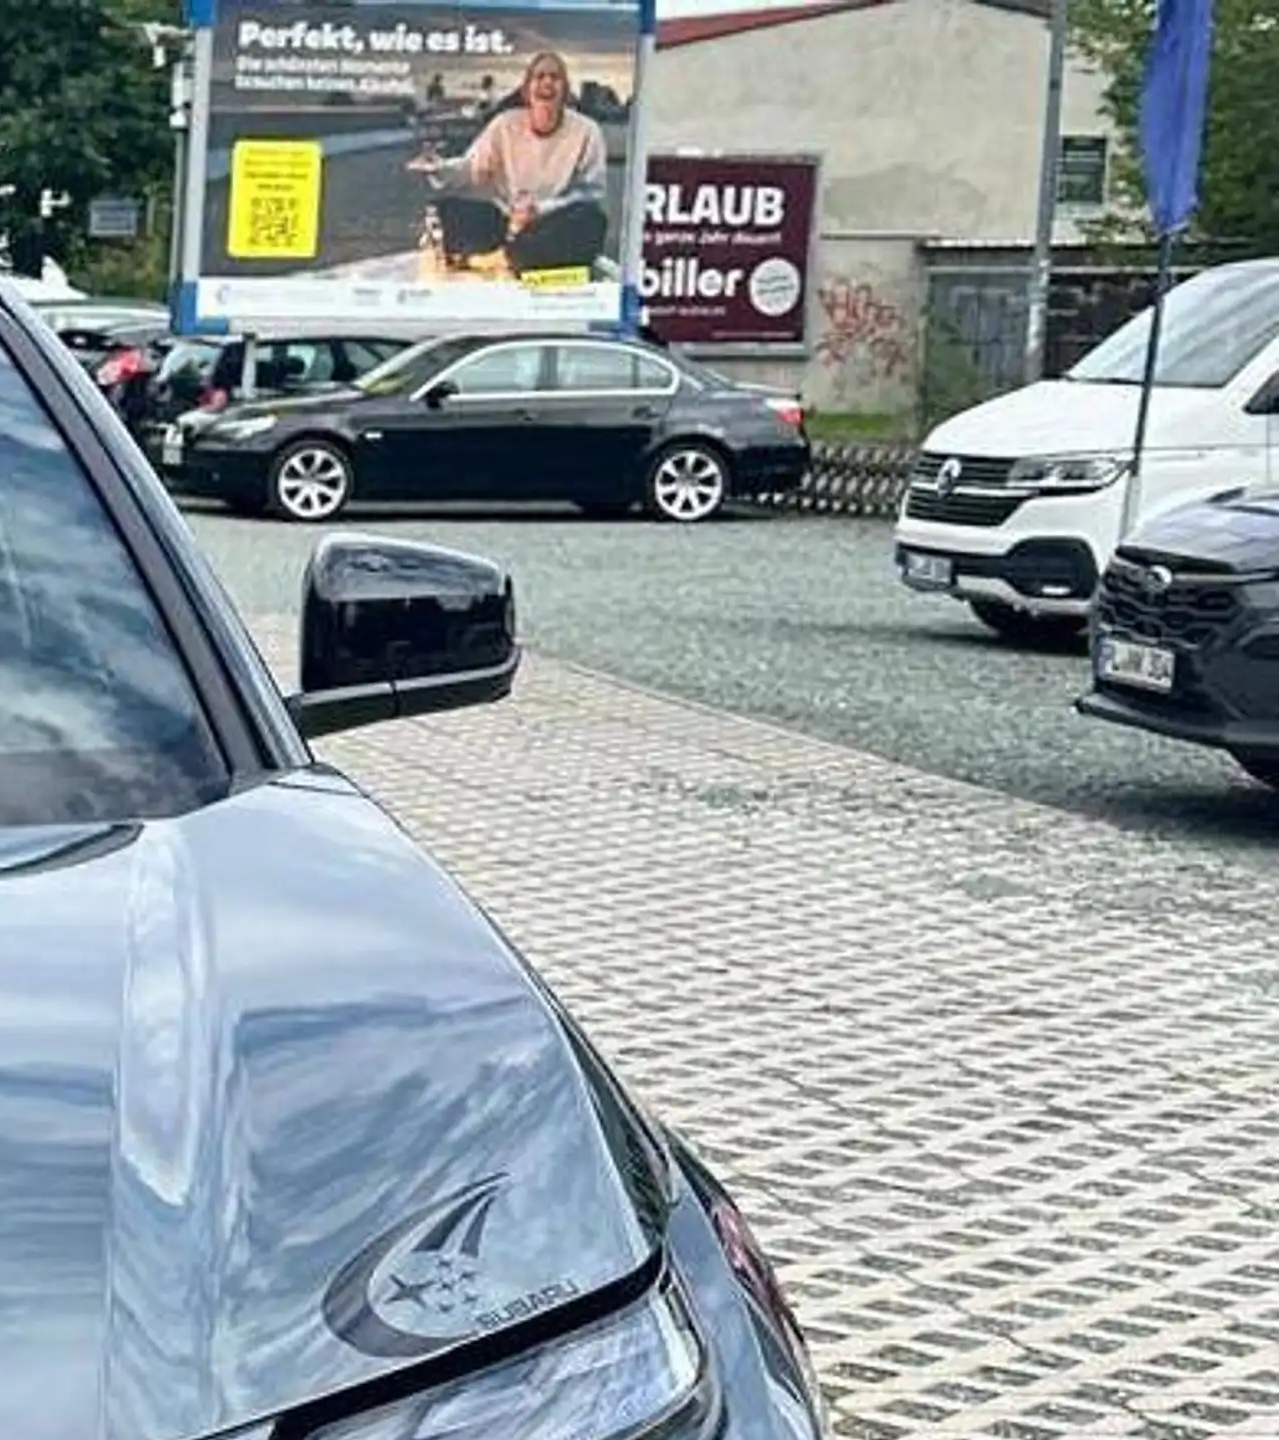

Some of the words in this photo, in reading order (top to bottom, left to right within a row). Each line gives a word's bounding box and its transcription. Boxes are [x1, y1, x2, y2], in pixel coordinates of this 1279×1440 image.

[238, 21, 365, 54] Perfekt,
[369, 23, 423, 52] wie
[426, 30, 459, 51] es
[463, 25, 514, 54] ist.
[642, 183, 785, 226] RLAUB
